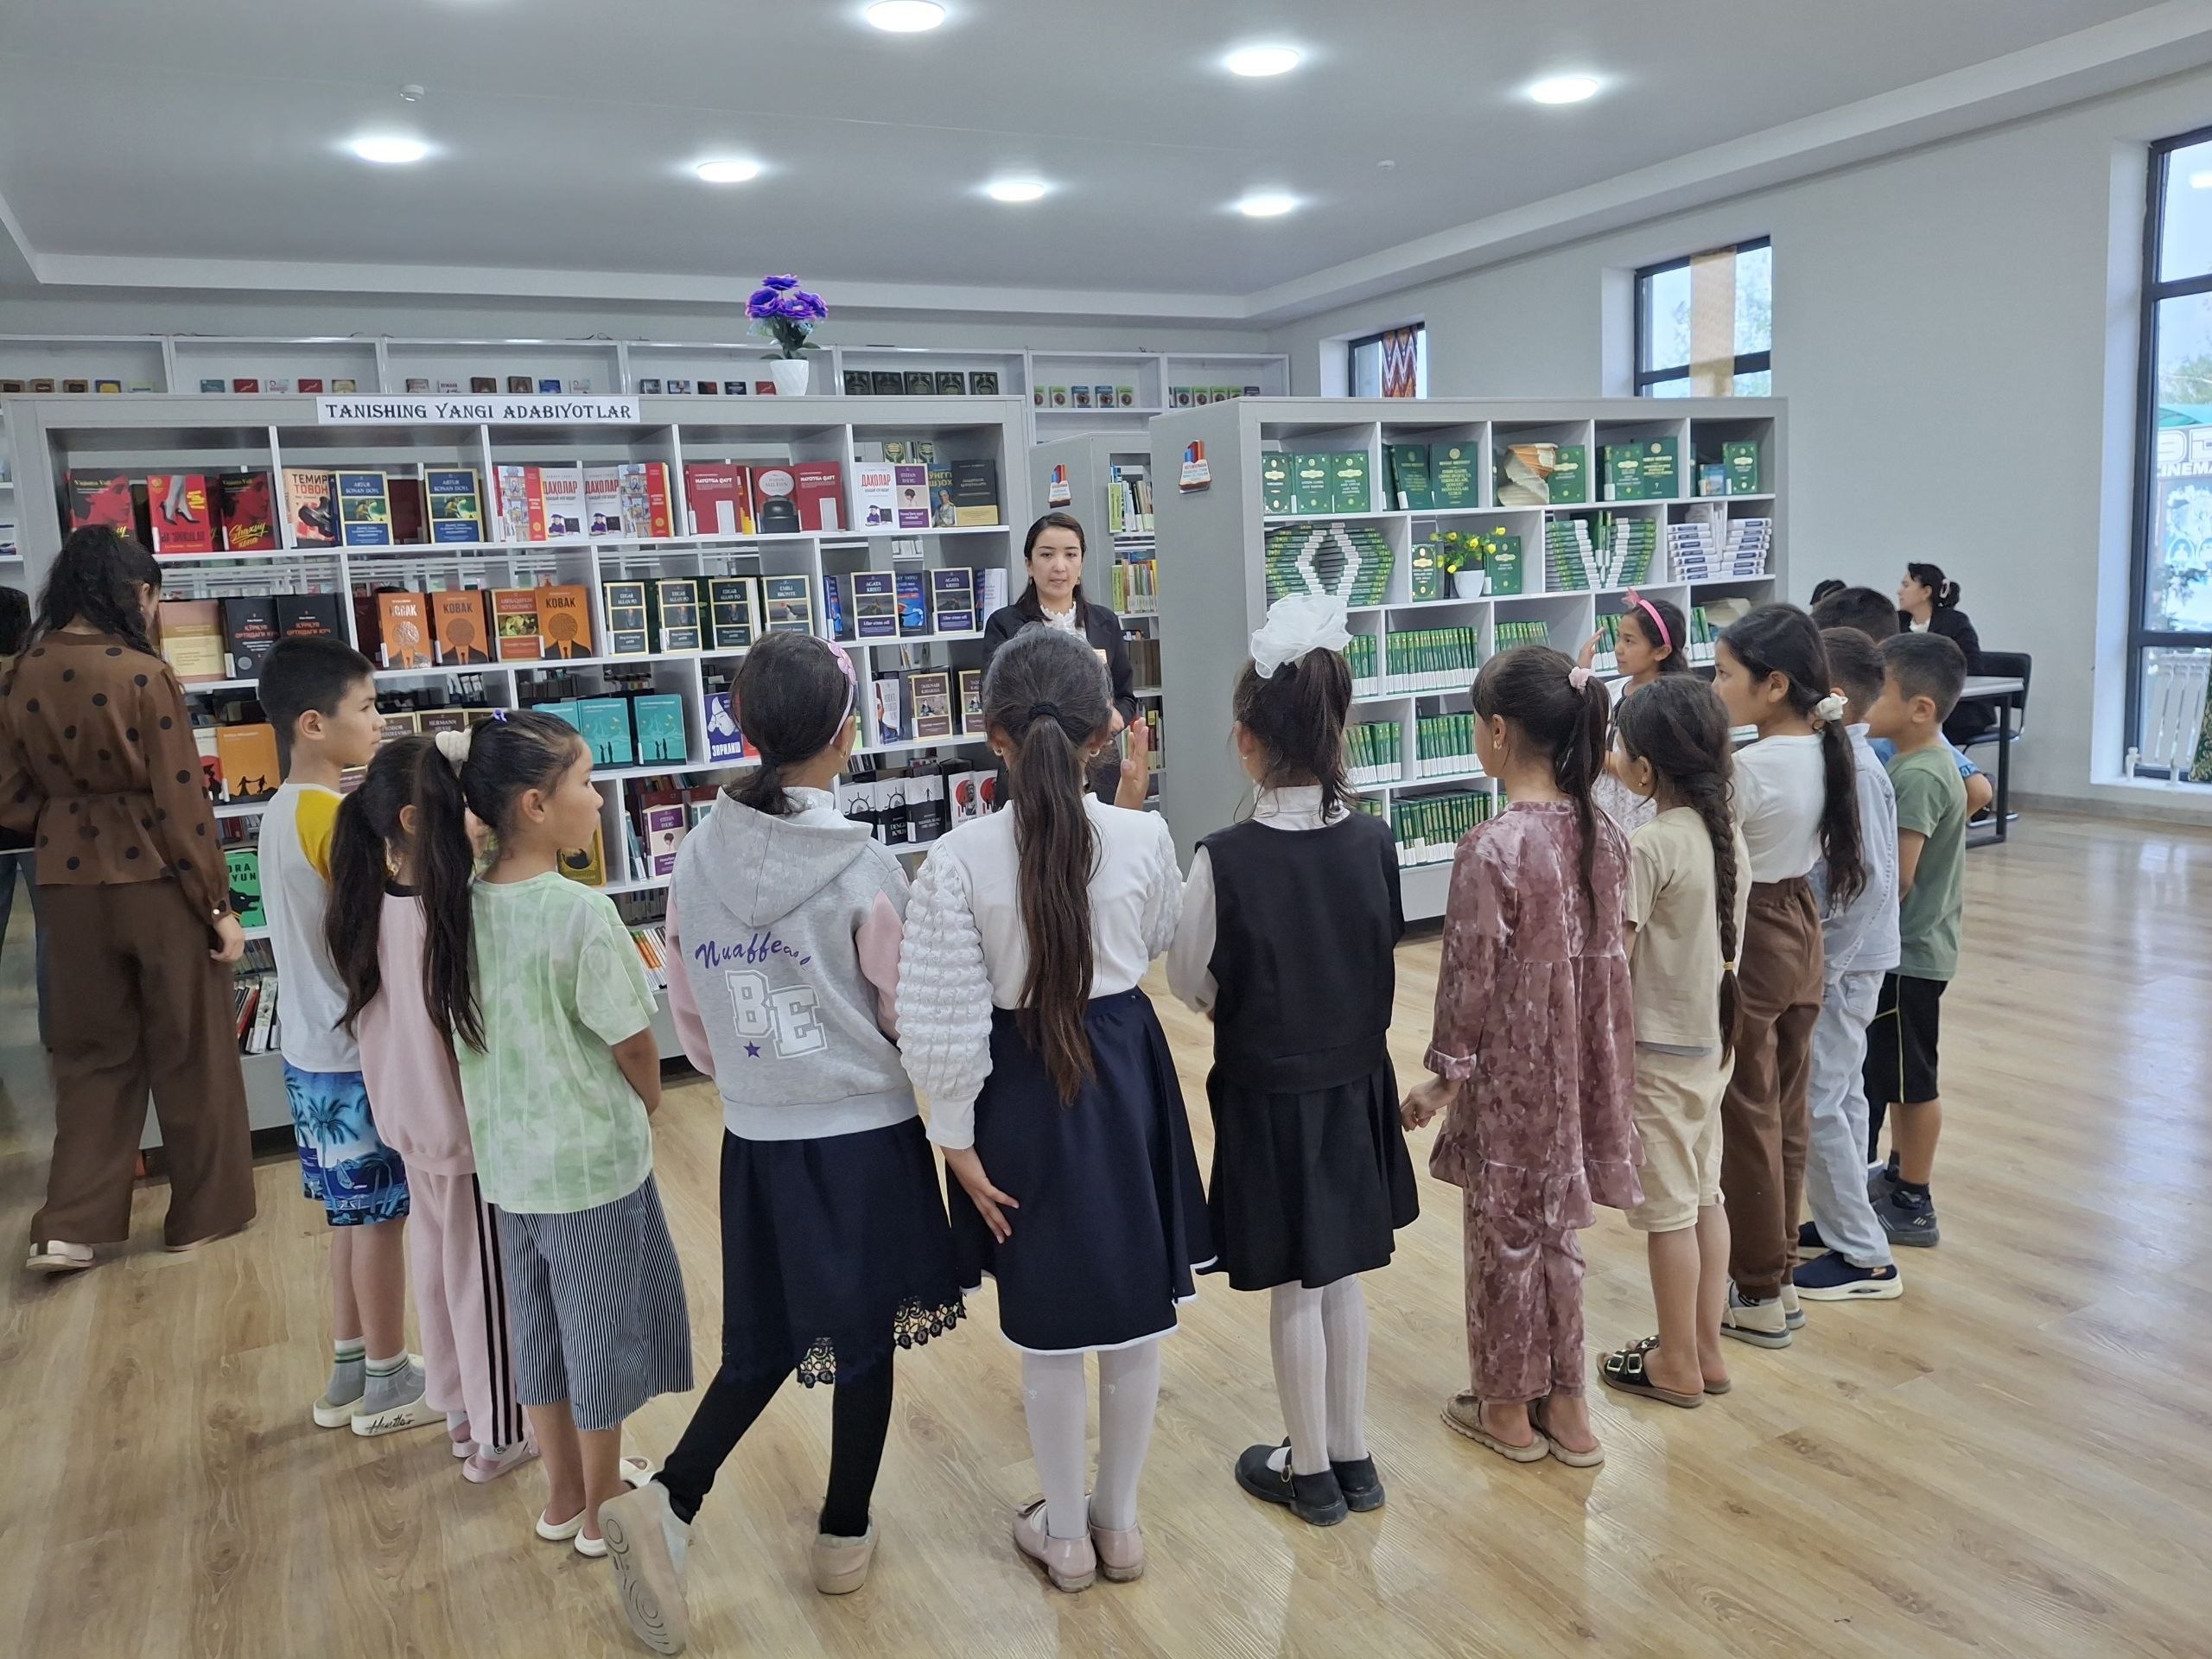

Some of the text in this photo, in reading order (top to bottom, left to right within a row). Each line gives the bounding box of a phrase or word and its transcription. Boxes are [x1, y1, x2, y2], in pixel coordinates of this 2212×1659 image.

[325, 402, 632, 419] TANISHING YANGI ADABIYOTLAR
[292, 474, 328, 485] ТЕМИР
[295, 483, 328, 495] ТОВОН
[724, 969, 829, 1059] BE
